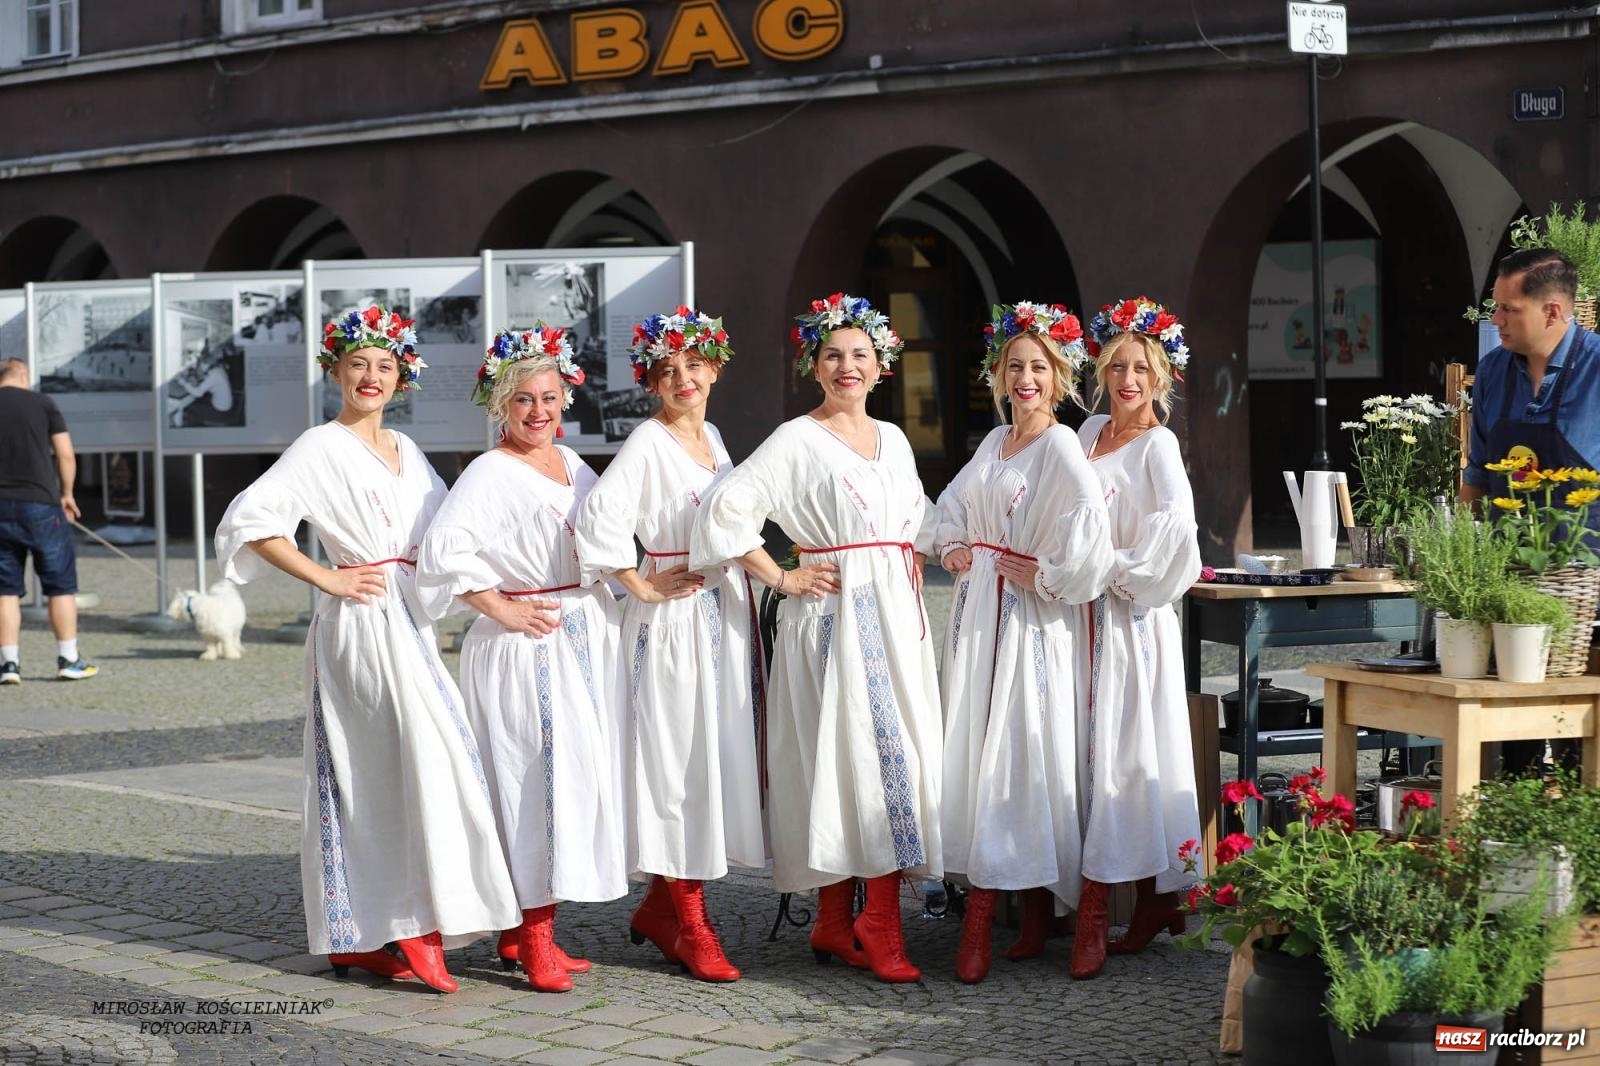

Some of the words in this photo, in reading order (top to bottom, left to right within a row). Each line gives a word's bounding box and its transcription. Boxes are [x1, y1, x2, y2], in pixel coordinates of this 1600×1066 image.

[1291, 5, 1307, 17] Nie
[1310, 7, 1344, 21] dotyczy
[479, 0, 844, 88] ABAC
[1520, 92, 1557, 116] Długa
